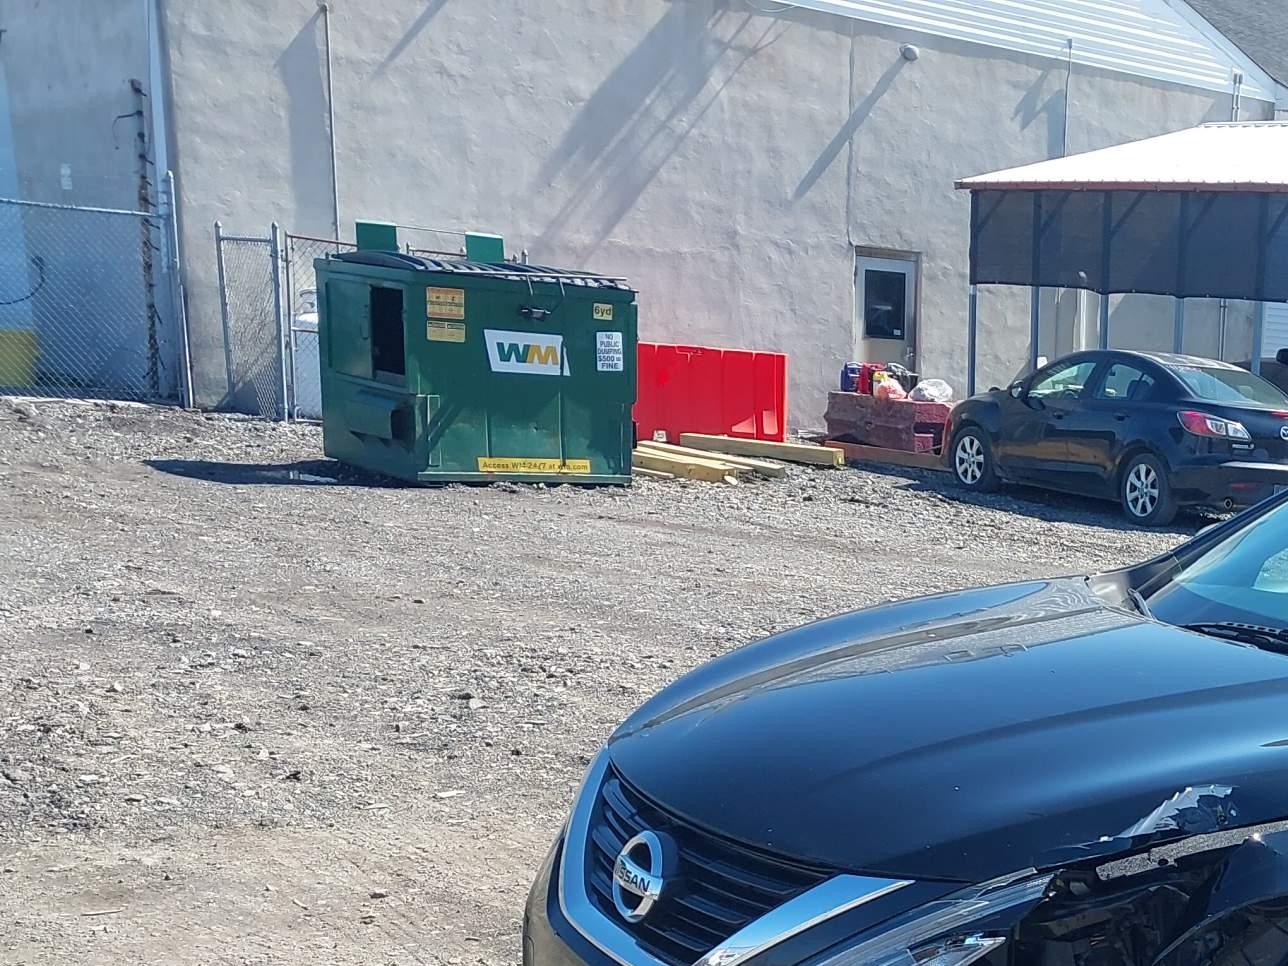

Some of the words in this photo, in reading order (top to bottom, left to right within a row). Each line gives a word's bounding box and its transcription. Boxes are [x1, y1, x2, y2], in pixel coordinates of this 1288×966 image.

[595, 306, 612, 317] 6yd
[496, 342, 559, 365] WM
[483, 461, 509, 469] Access
